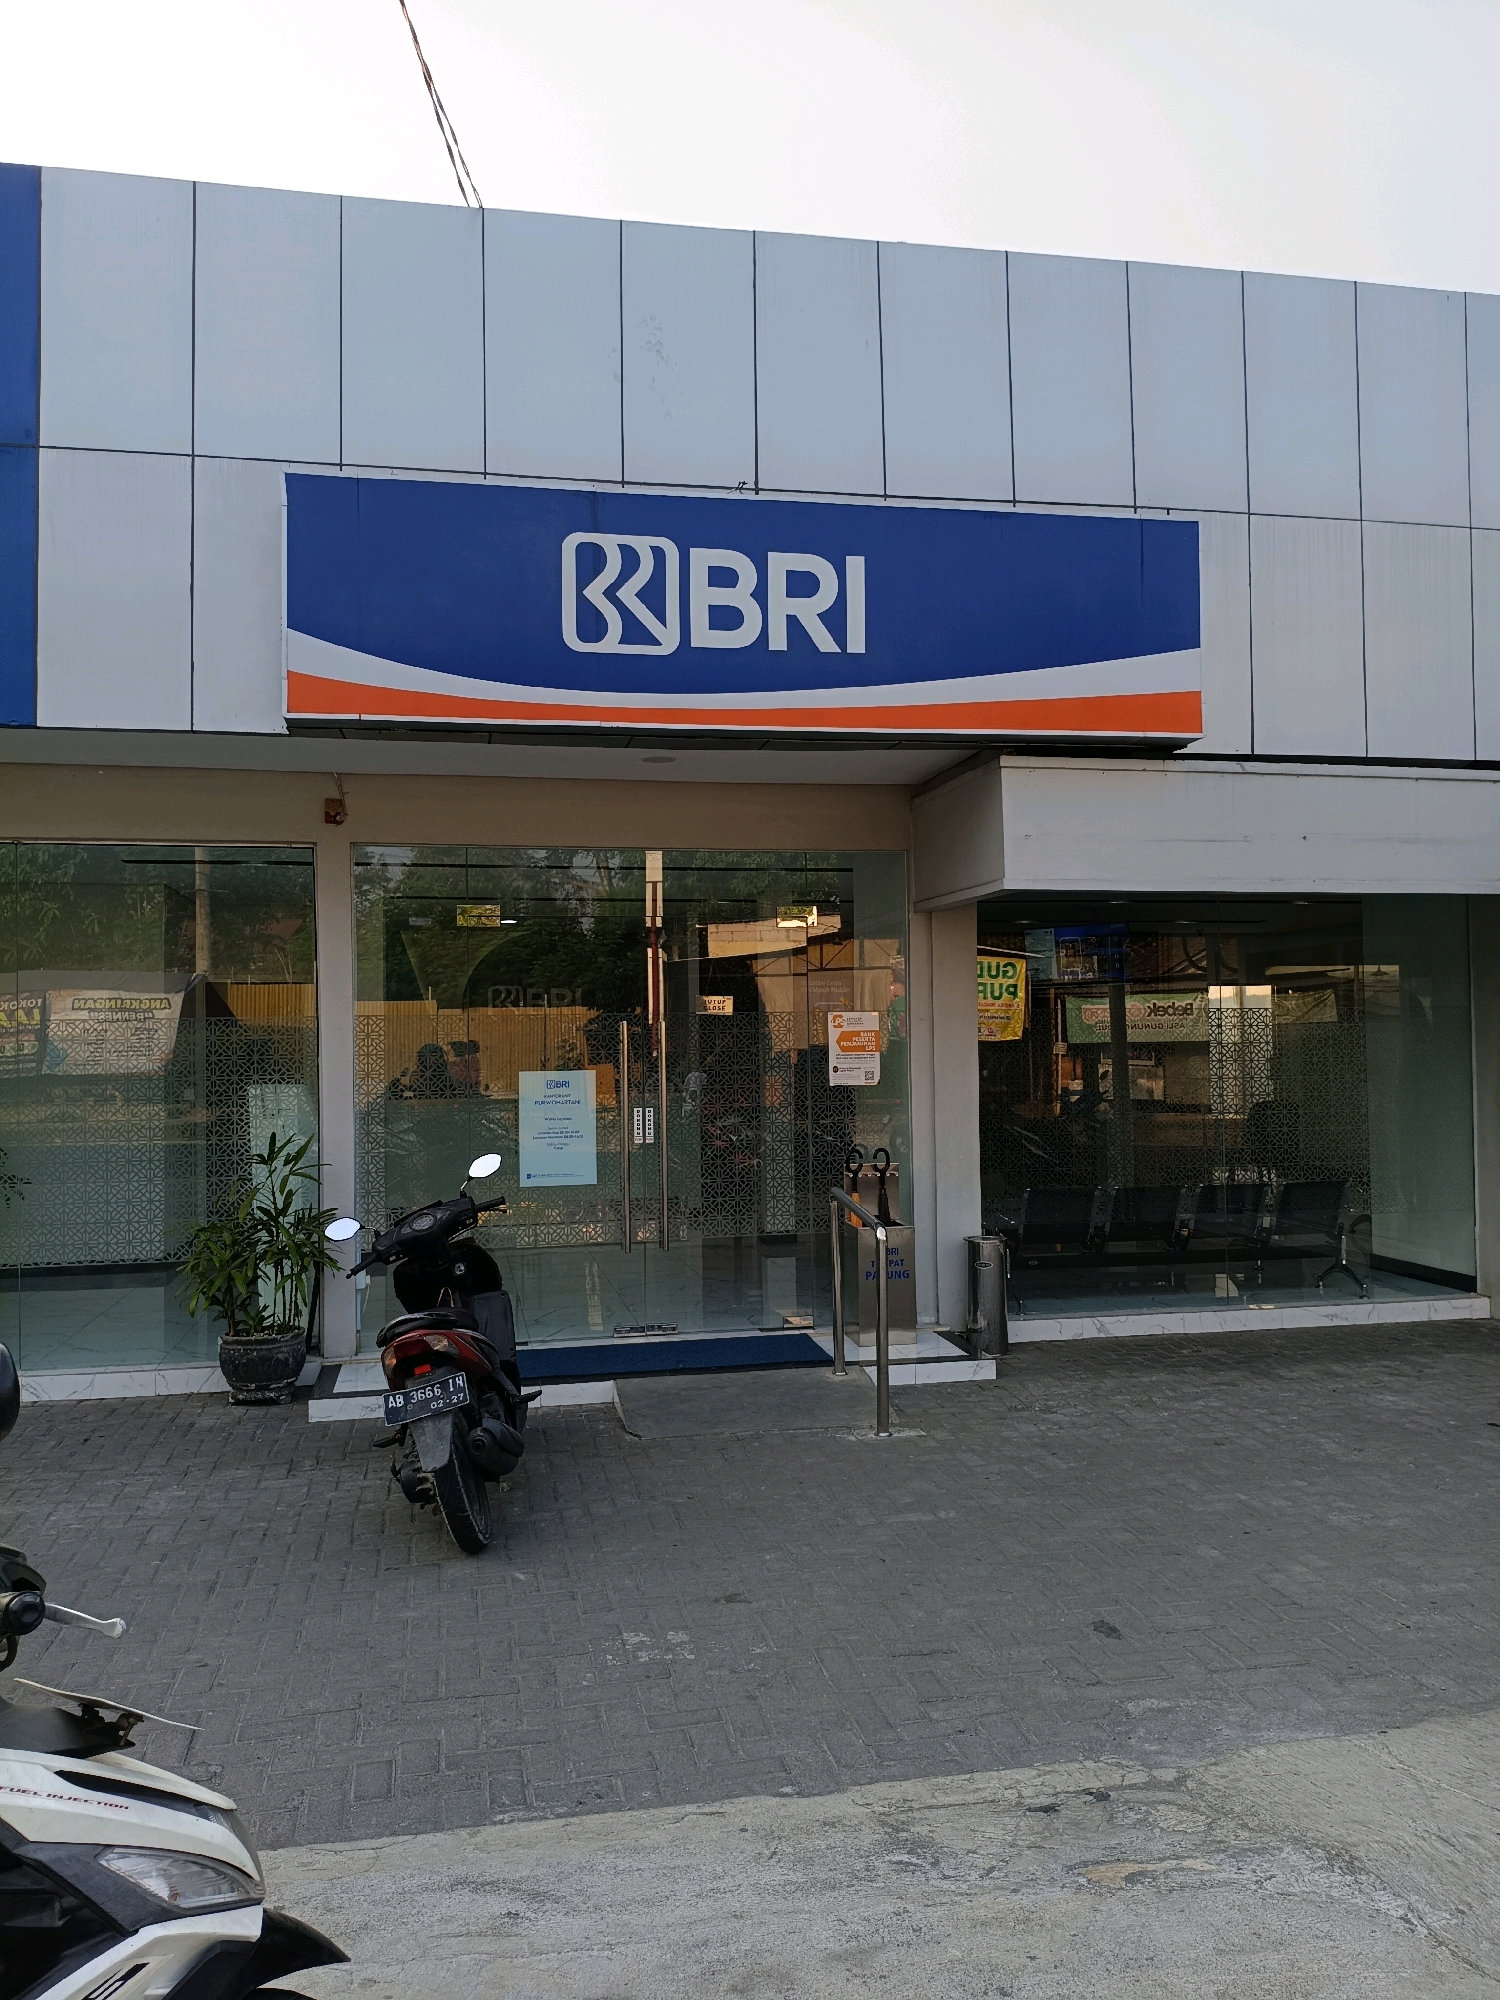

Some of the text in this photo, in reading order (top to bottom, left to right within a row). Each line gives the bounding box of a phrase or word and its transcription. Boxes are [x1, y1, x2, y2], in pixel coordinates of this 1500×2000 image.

[689, 546, 867, 655] BRI
[555, 1080, 570, 1089] BRI
[870, 1259, 905, 1267] TPAT
[866, 1270, 910, 1280] PAUNG
[388, 1394, 405, 1409] AB
[410, 1384, 442, 1403] 3666
[0, 1786, 130, 1810] FUEL INJECTION
